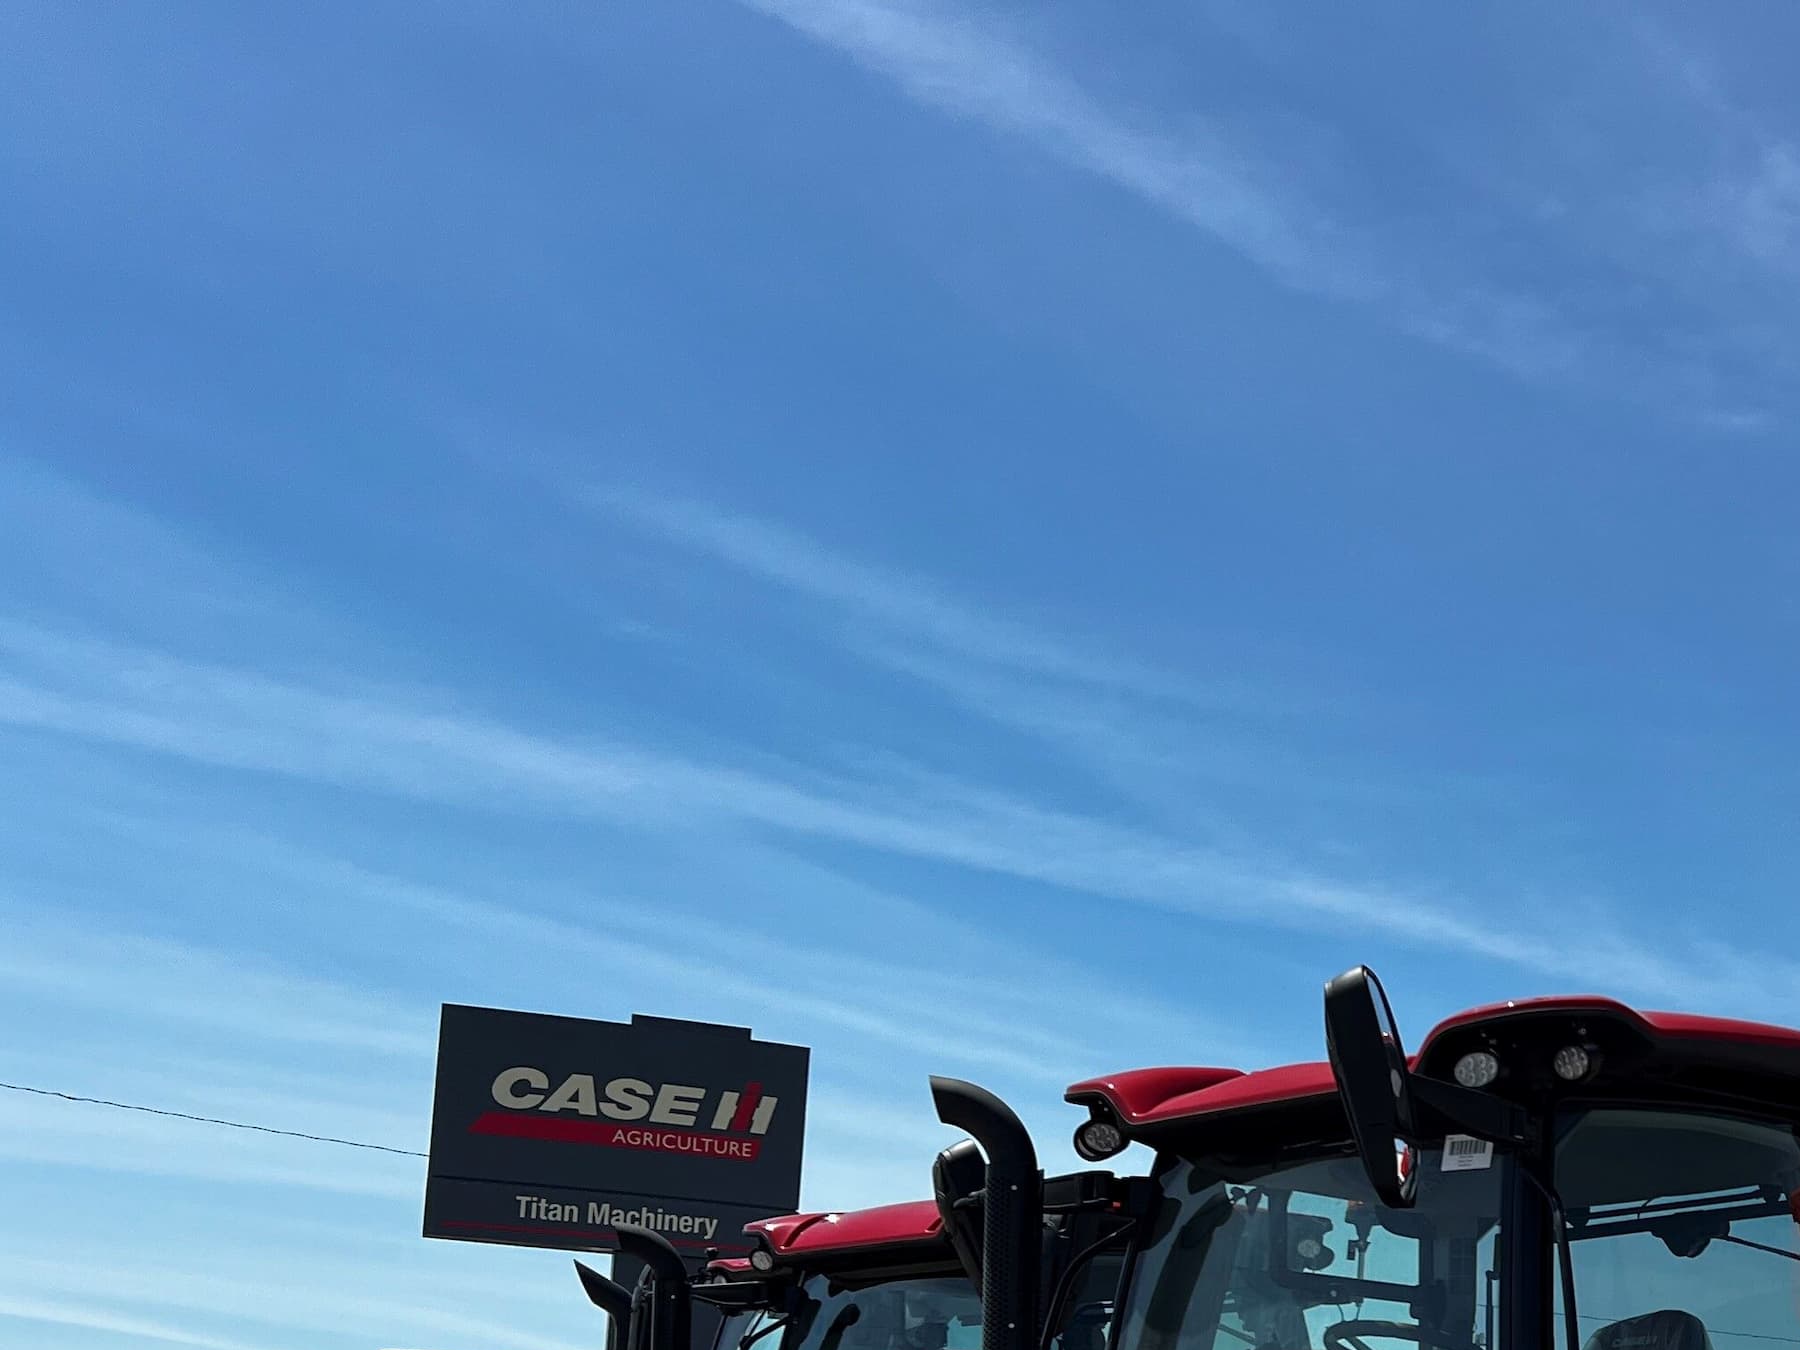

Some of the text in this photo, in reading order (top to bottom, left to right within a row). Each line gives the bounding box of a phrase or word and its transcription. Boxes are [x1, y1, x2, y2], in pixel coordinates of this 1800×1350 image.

[491, 1066, 706, 1127] CASE
[612, 1129, 752, 1158] AGRICULTURE
[515, 1195, 719, 1240] Titan Machinery
